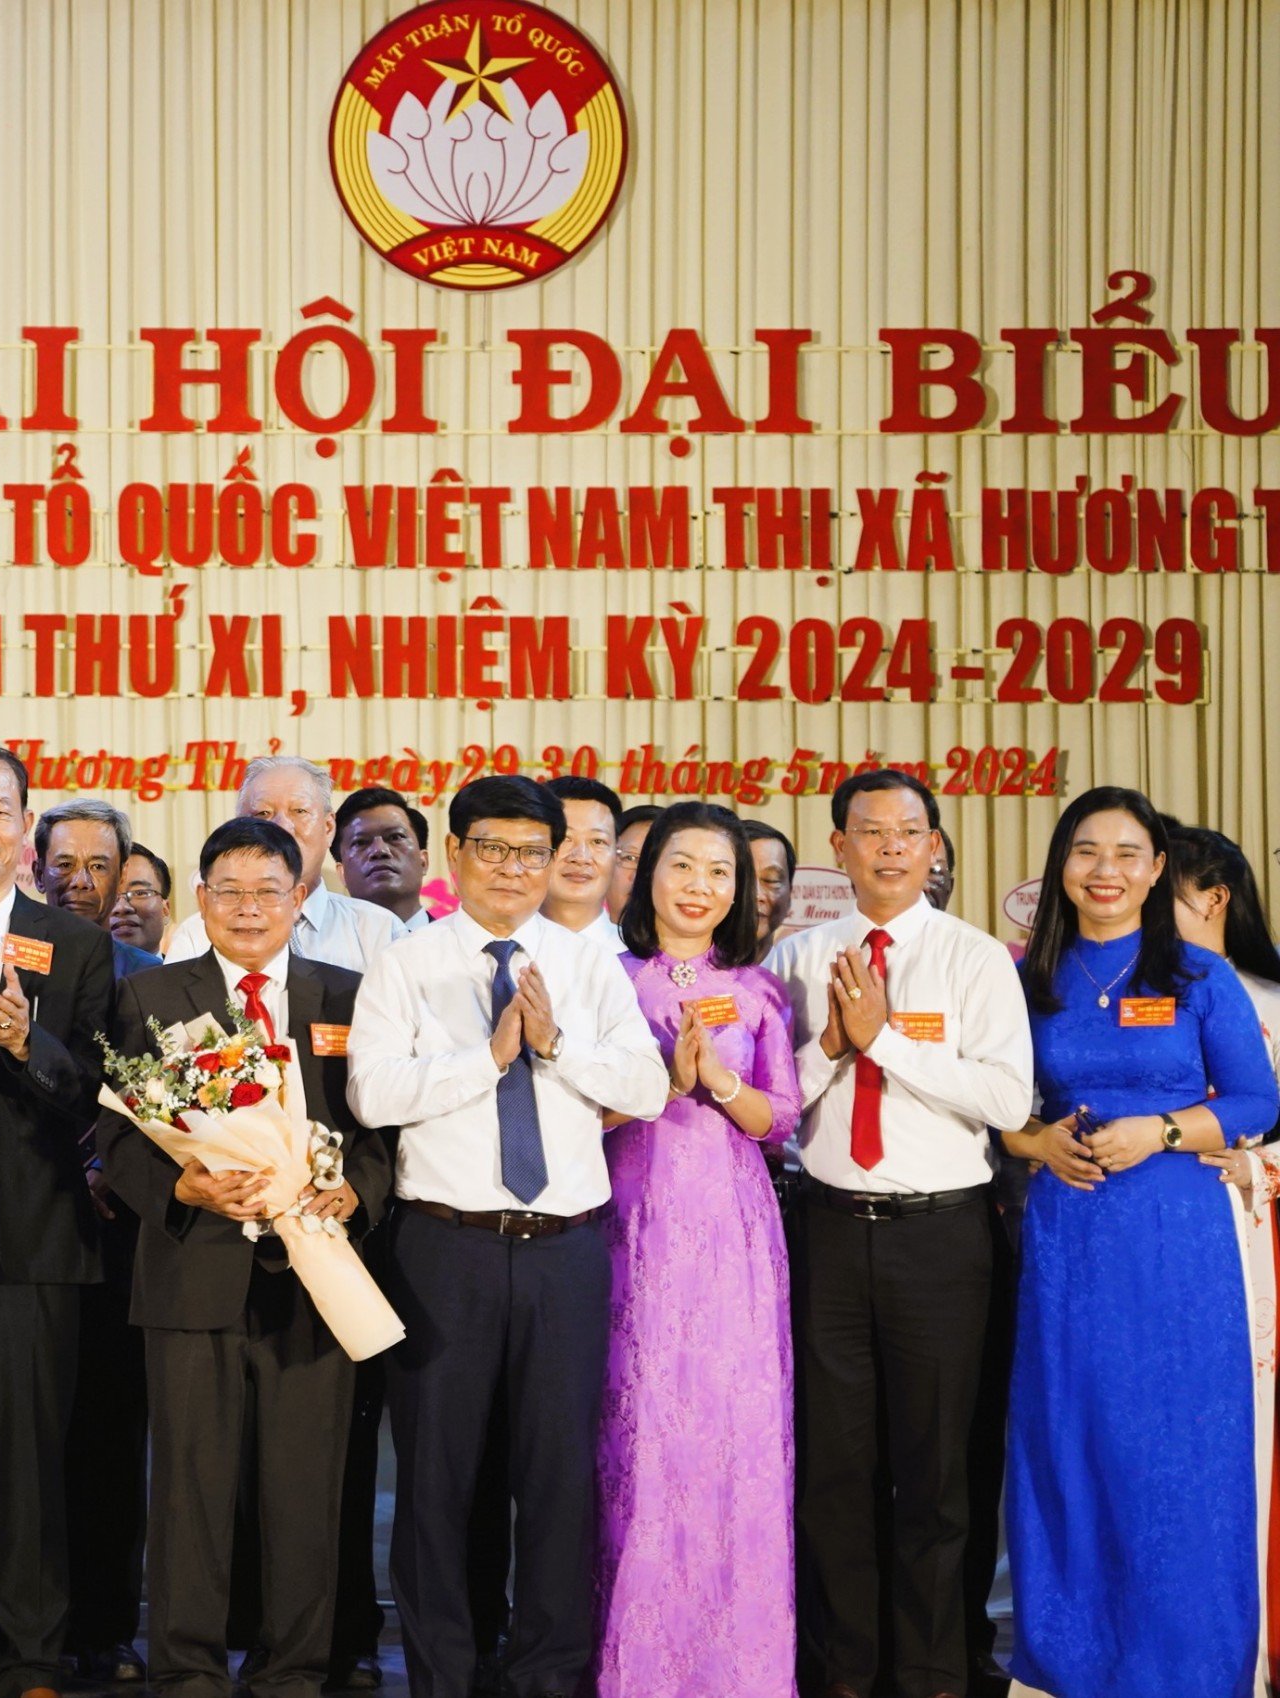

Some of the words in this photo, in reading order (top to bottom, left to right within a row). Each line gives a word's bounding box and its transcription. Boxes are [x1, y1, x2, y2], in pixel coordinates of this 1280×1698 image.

[364, 42, 405, 90] MẶT
[405, 13, 472, 48] TRẬN
[491, 12, 526, 36] TỔ
[527, 27, 586, 78] QUỐC
[412, 235, 475, 268] VIỆT
[483, 237, 541, 268] NAM
[139, 295, 439, 459] HỘI
[507, 328, 813, 458] ĐẠI
[879, 270, 1280, 436] BIỂU
[3, 442, 93, 569] TỔ
[117, 446, 318, 577] QUỐC
[343, 467, 511, 583] VIỆT
[527, 486, 690, 571] NAM
[712, 486, 832, 587] THỊ
[854, 470, 956, 573] XÃ
[981, 474, 1238, 575] HƯƠNG
[23, 583, 188, 698] THỨ
[204, 613, 308, 717] XI,
[328, 594, 571, 712] NHIỆM
[605, 601, 705, 702] KỲ
[4, 738, 172, 803] Hương
[327, 746, 454, 807] ngày
[618, 742, 771, 806] tháng
[780, 747, 817, 796] 5
[941, 744, 1059, 797] 2024
